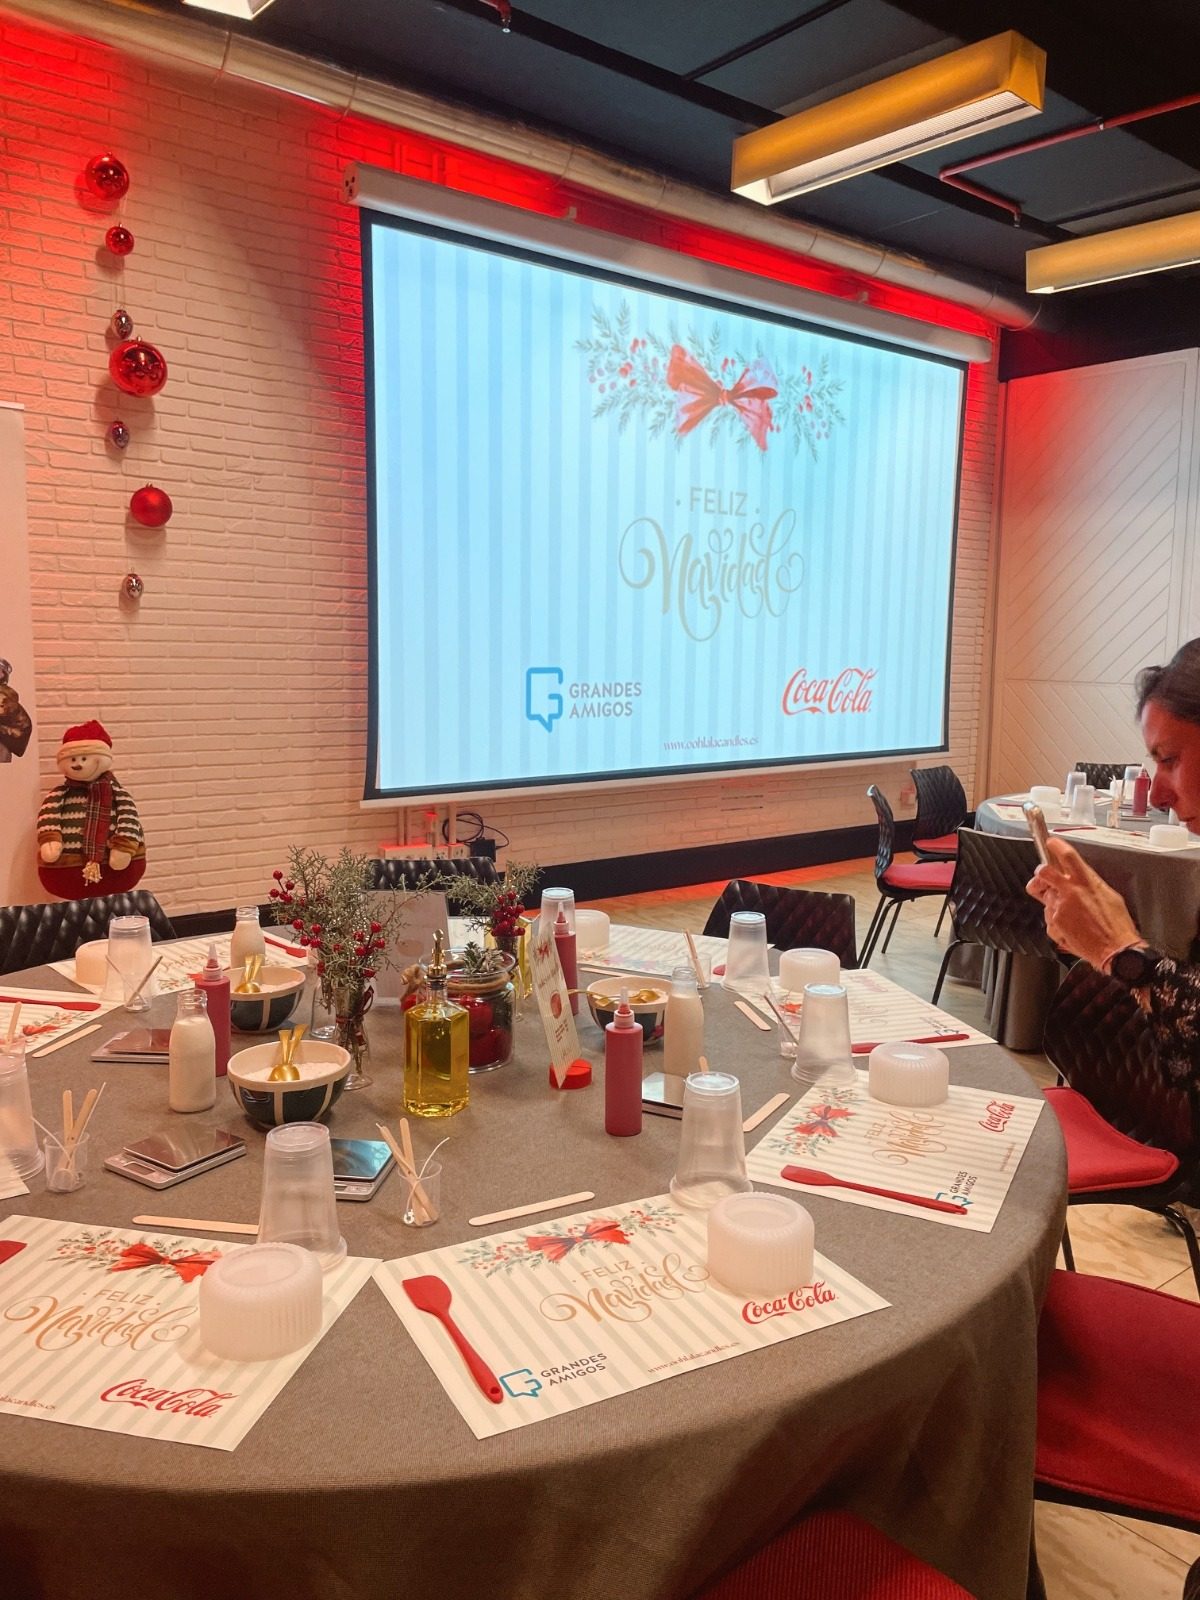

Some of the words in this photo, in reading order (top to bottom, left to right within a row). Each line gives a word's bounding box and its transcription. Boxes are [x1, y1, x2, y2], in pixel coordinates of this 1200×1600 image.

[690, 486, 748, 517] FELIZ
[619, 508, 805, 642] Navidad
[569, 681, 642, 699] GRANDES
[782, 667, 878, 716] Coca-Cola
[569, 701, 633, 719] AMIGOS
[949, 1171, 968, 1193] GRANDES
[962, 1175, 978, 1196] AMIGOS
[580, 1260, 634, 1283] FELIZ
[94, 1288, 154, 1306] FELIZ
[539, 1252, 711, 1324] Navidad
[3, 1295, 198, 1352] Navidad
[540, 1352, 607, 1379] GRANDES
[549, 1362, 607, 1388] AMIGOS
